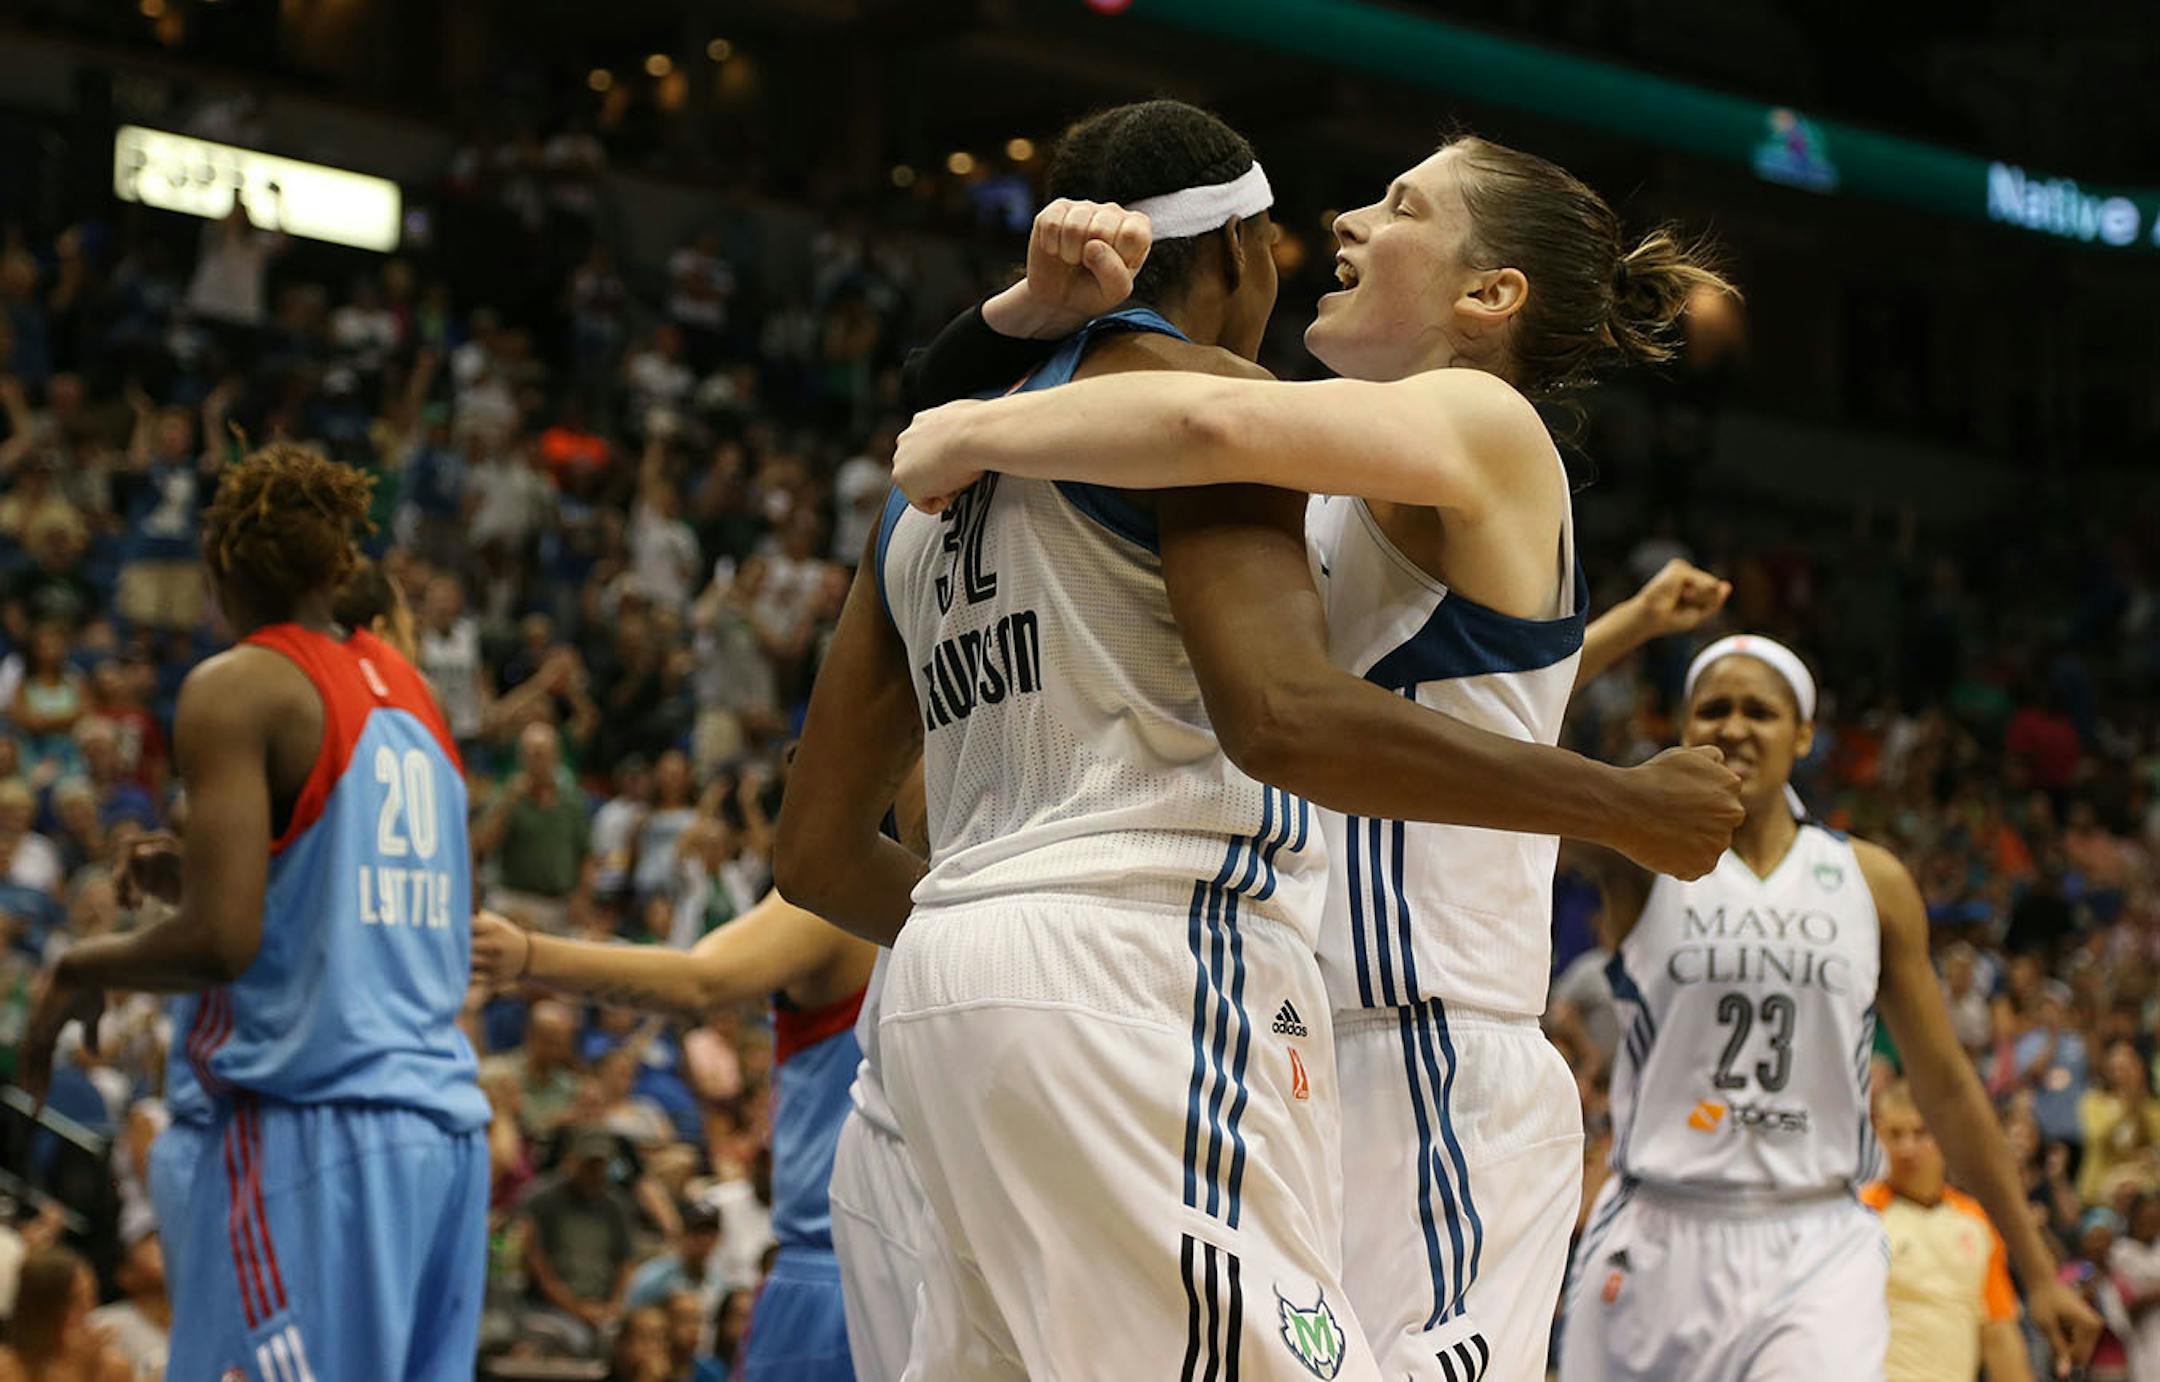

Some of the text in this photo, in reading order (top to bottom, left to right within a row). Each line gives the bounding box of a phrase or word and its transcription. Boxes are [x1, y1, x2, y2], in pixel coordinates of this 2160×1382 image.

[1987, 161, 2140, 246] Native
[374, 746, 438, 859] 20
[1682, 905, 1838, 945] MAYO
[1667, 948, 1851, 994] CLINIC
[1713, 992, 1796, 1093] 23
